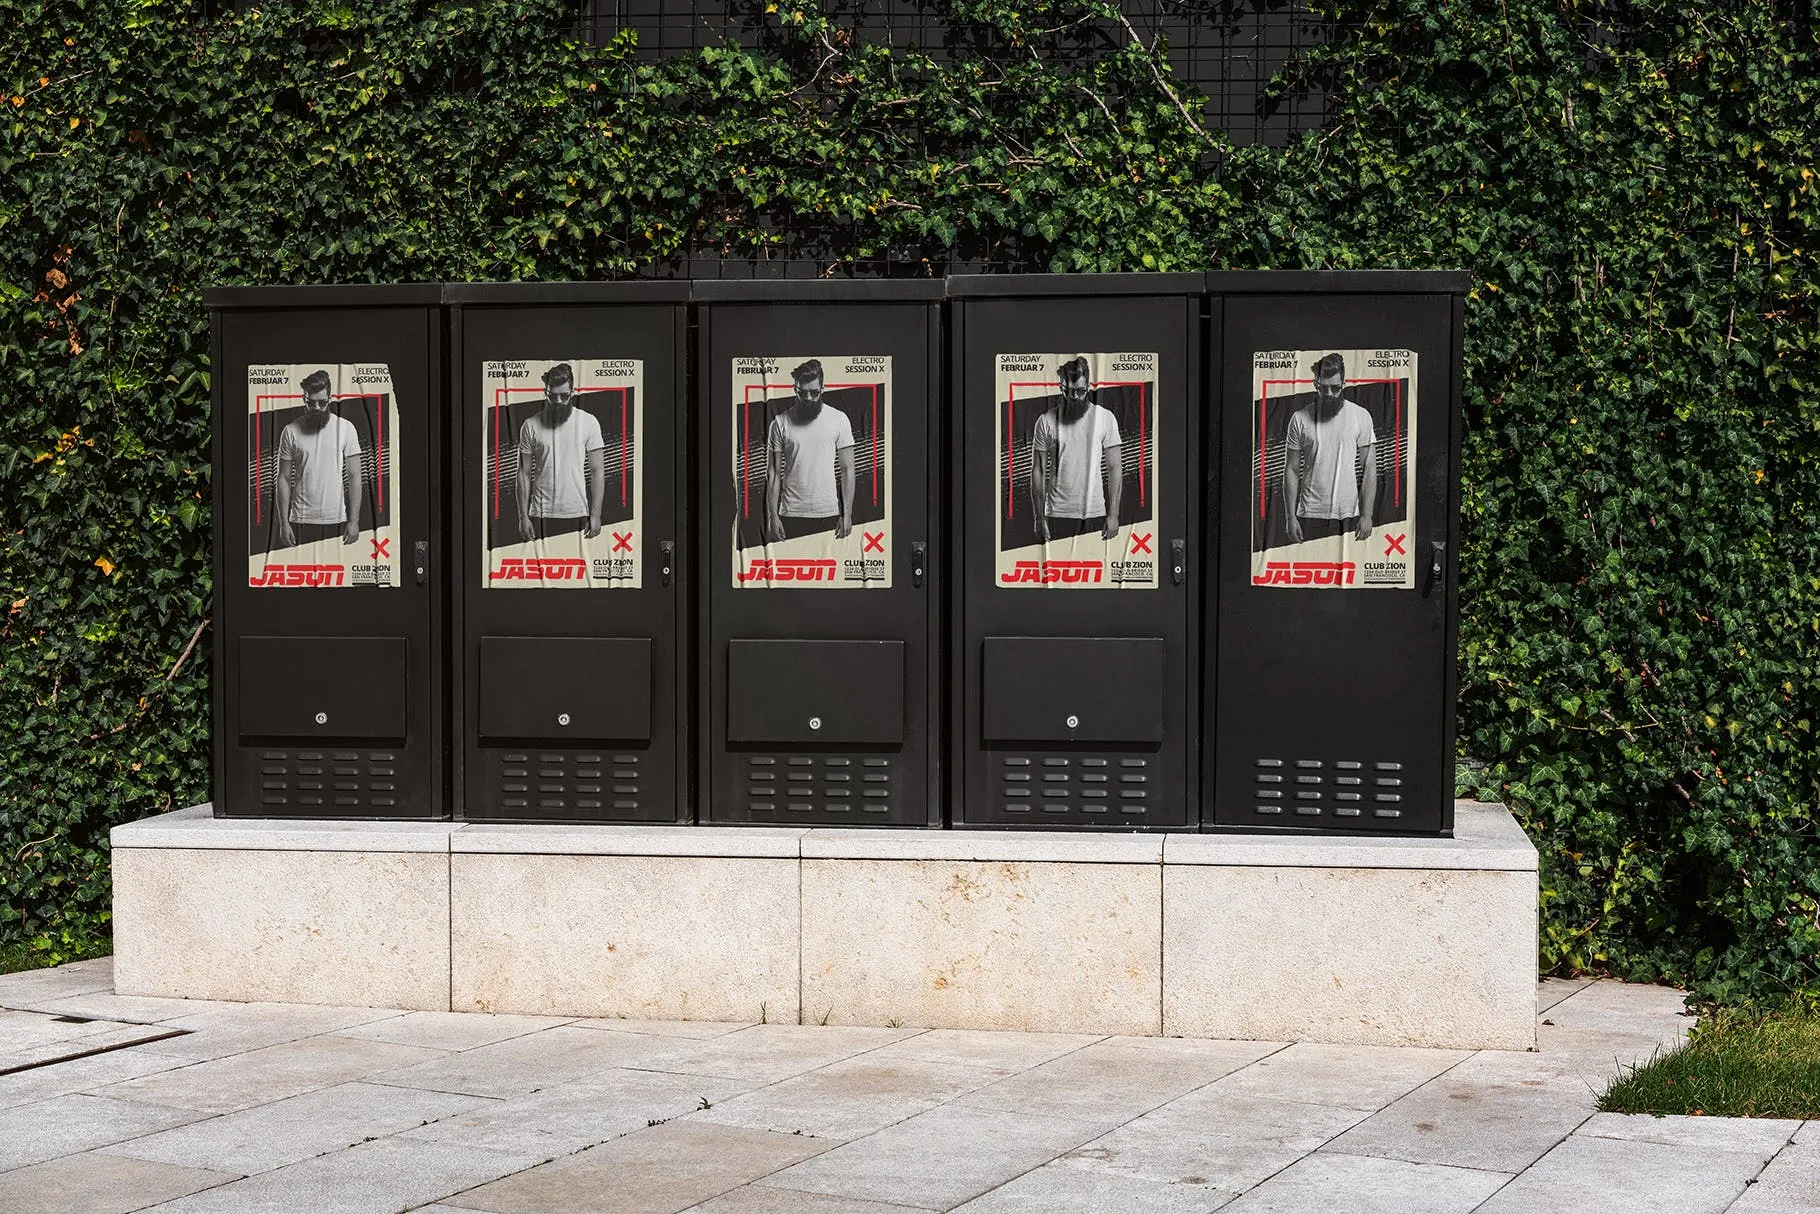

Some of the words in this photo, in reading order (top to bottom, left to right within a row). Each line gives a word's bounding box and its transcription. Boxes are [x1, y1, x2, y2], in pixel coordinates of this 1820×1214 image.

[1000, 355, 1041, 363] SATURDAY
[1119, 354, 1153, 362] ELECTRO
[1254, 352, 1296, 360] SATURDAY
[602, 361, 634, 369] ELECTRO
[737, 358, 776, 367] SATUAY
[1254, 361, 1292, 369] FEBRUAR
[1368, 360, 1401, 368] SESSION
[1402, 359, 1409, 367] X
[845, 365, 878, 373] SESSION
[1112, 363, 1145, 371] SESSION
[1146, 363, 1153, 371] X
[249, 368, 286, 376] SATURDAY
[595, 369, 628, 377] SESSION
[628, 369, 635, 377] X
[249, 377, 283, 385] FEBRUAR
[283, 377, 289, 385] 7
[352, 375, 382, 385] SESSION
[383, 375, 390, 383] X
